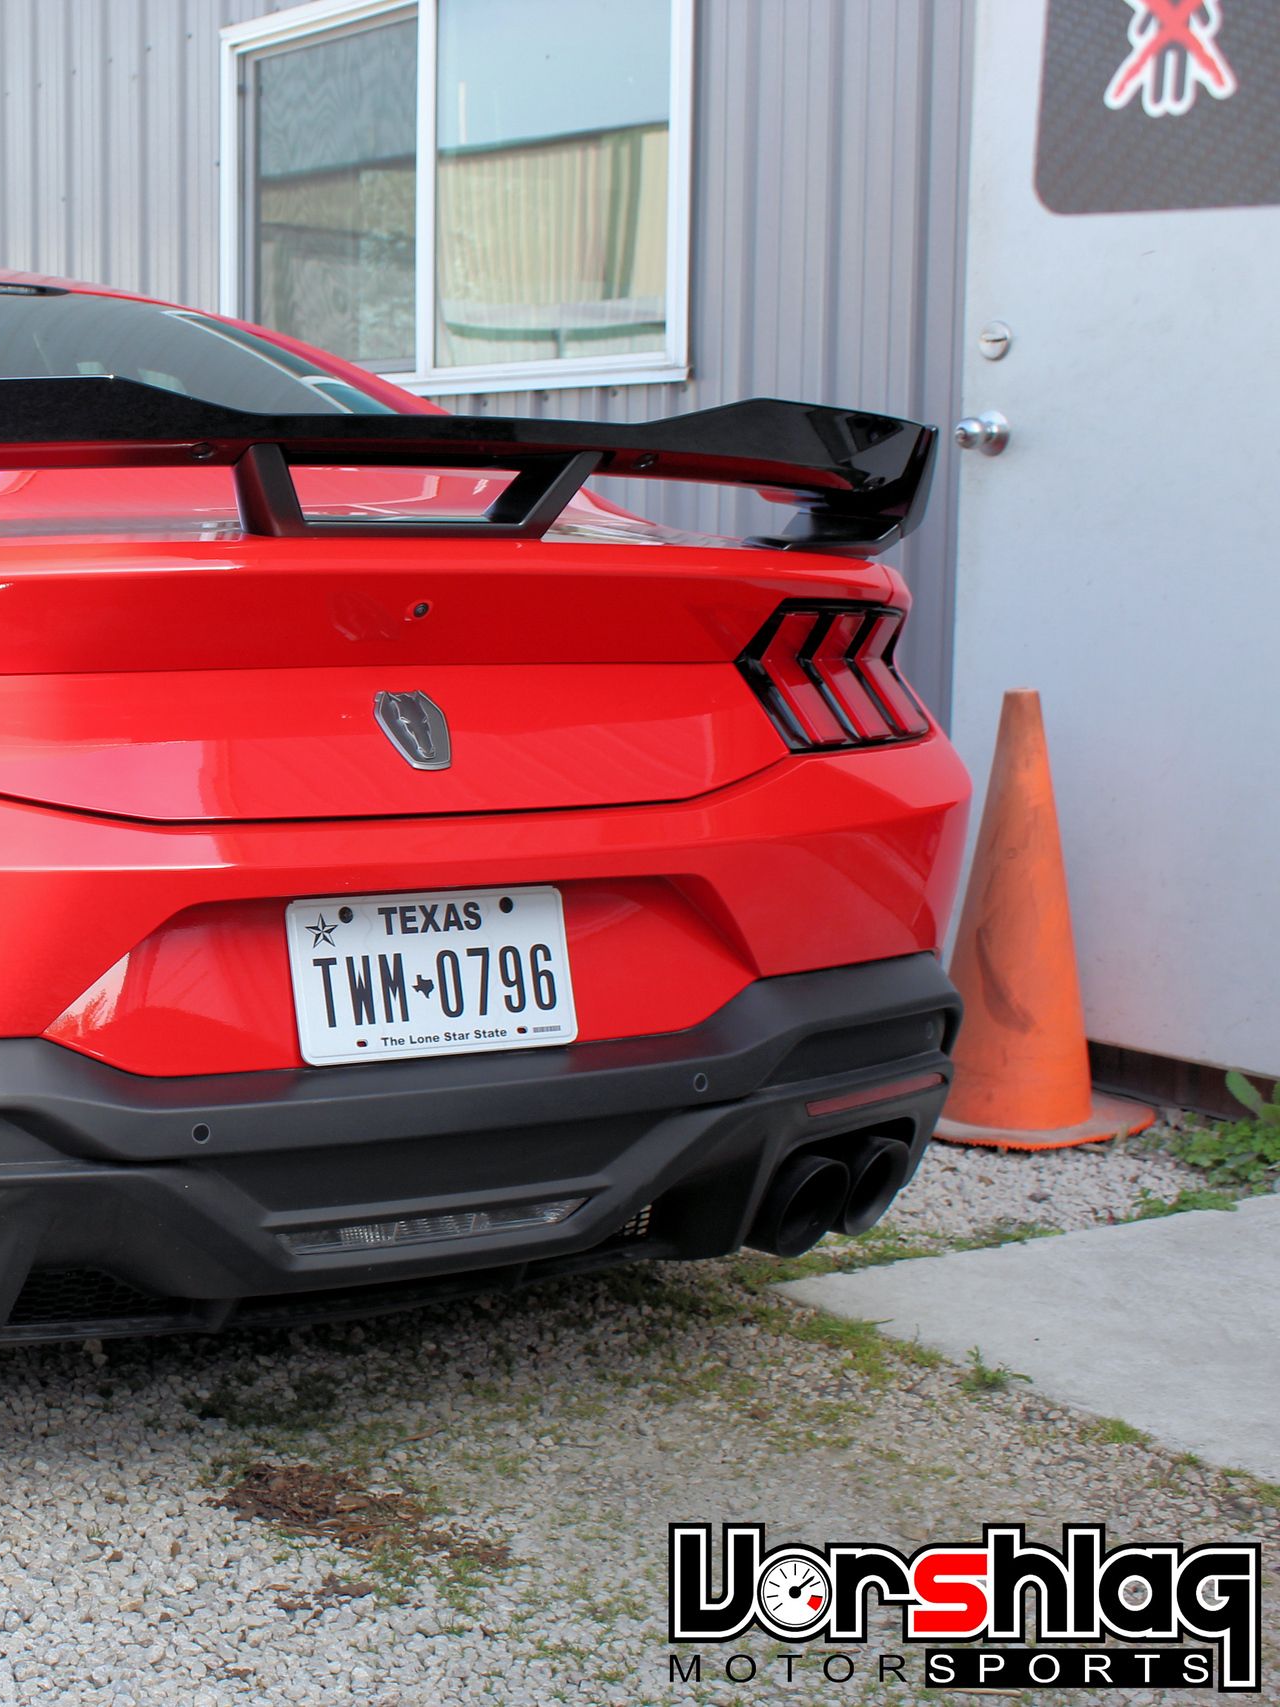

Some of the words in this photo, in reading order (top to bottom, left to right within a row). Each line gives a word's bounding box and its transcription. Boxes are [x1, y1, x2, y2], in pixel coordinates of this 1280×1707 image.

[377, 901, 482, 936] TEXAS
[381, 1036, 406, 1047] The
[409, 1035, 440, 1045] Lone
[443, 1032, 470, 1042] Star
[474, 1029, 508, 1039] State
